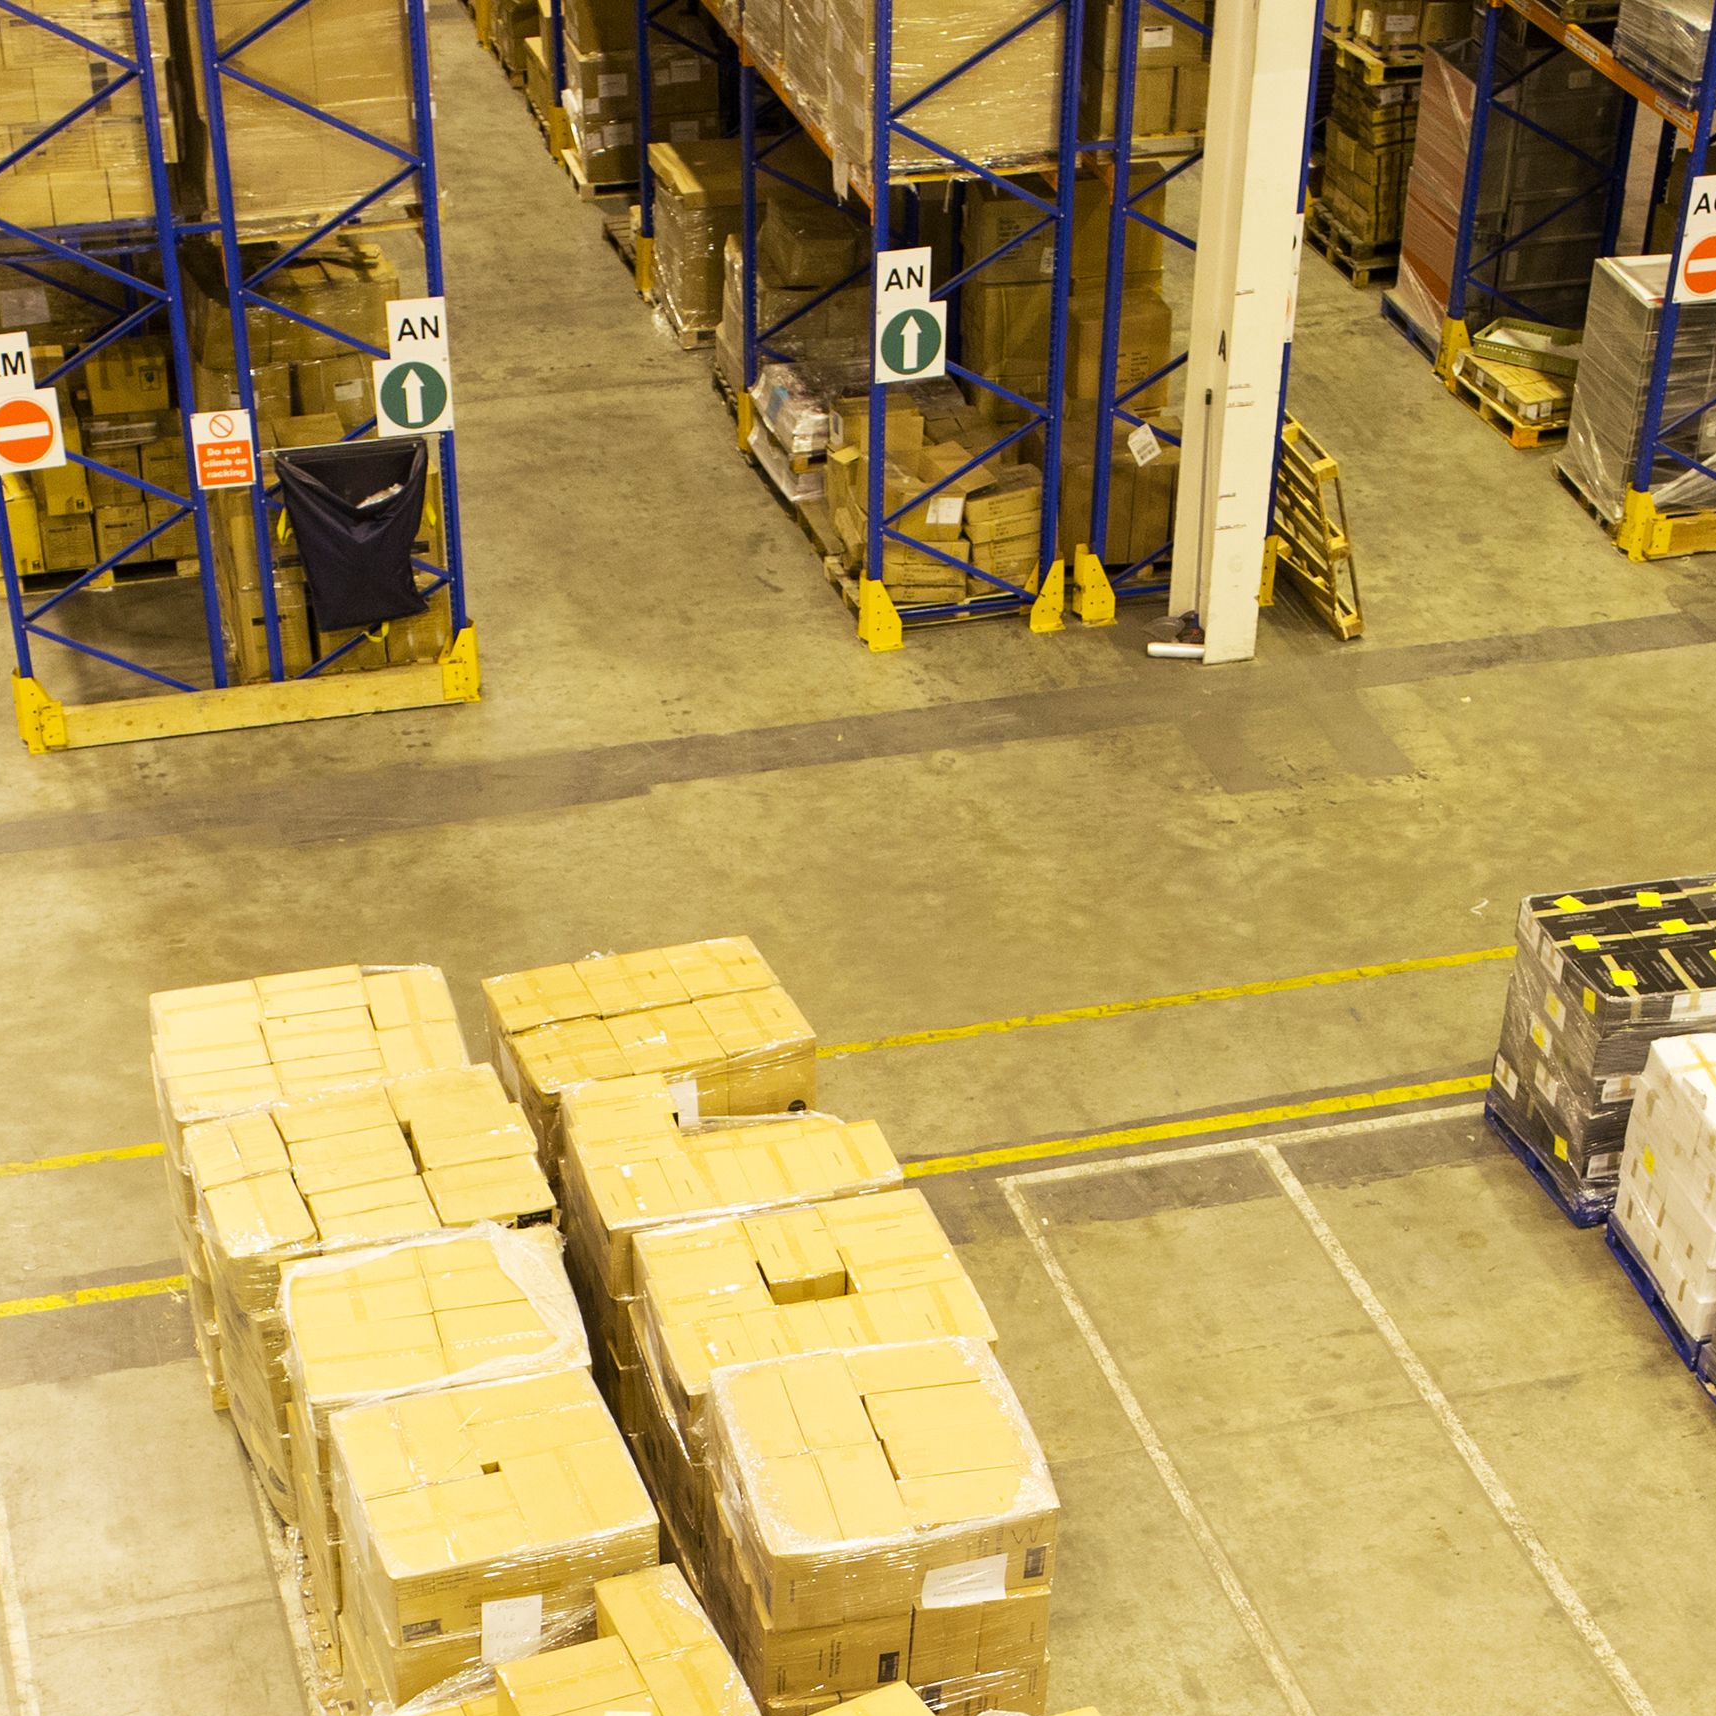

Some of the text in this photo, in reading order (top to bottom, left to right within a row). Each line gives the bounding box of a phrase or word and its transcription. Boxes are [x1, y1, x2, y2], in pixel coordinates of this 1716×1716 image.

[885, 266, 924, 292] AN
[398, 316, 440, 342] AN
[206, 446, 242, 457] Do not
[202, 458, 248, 468] climb on
[206, 469, 247, 479] racking
